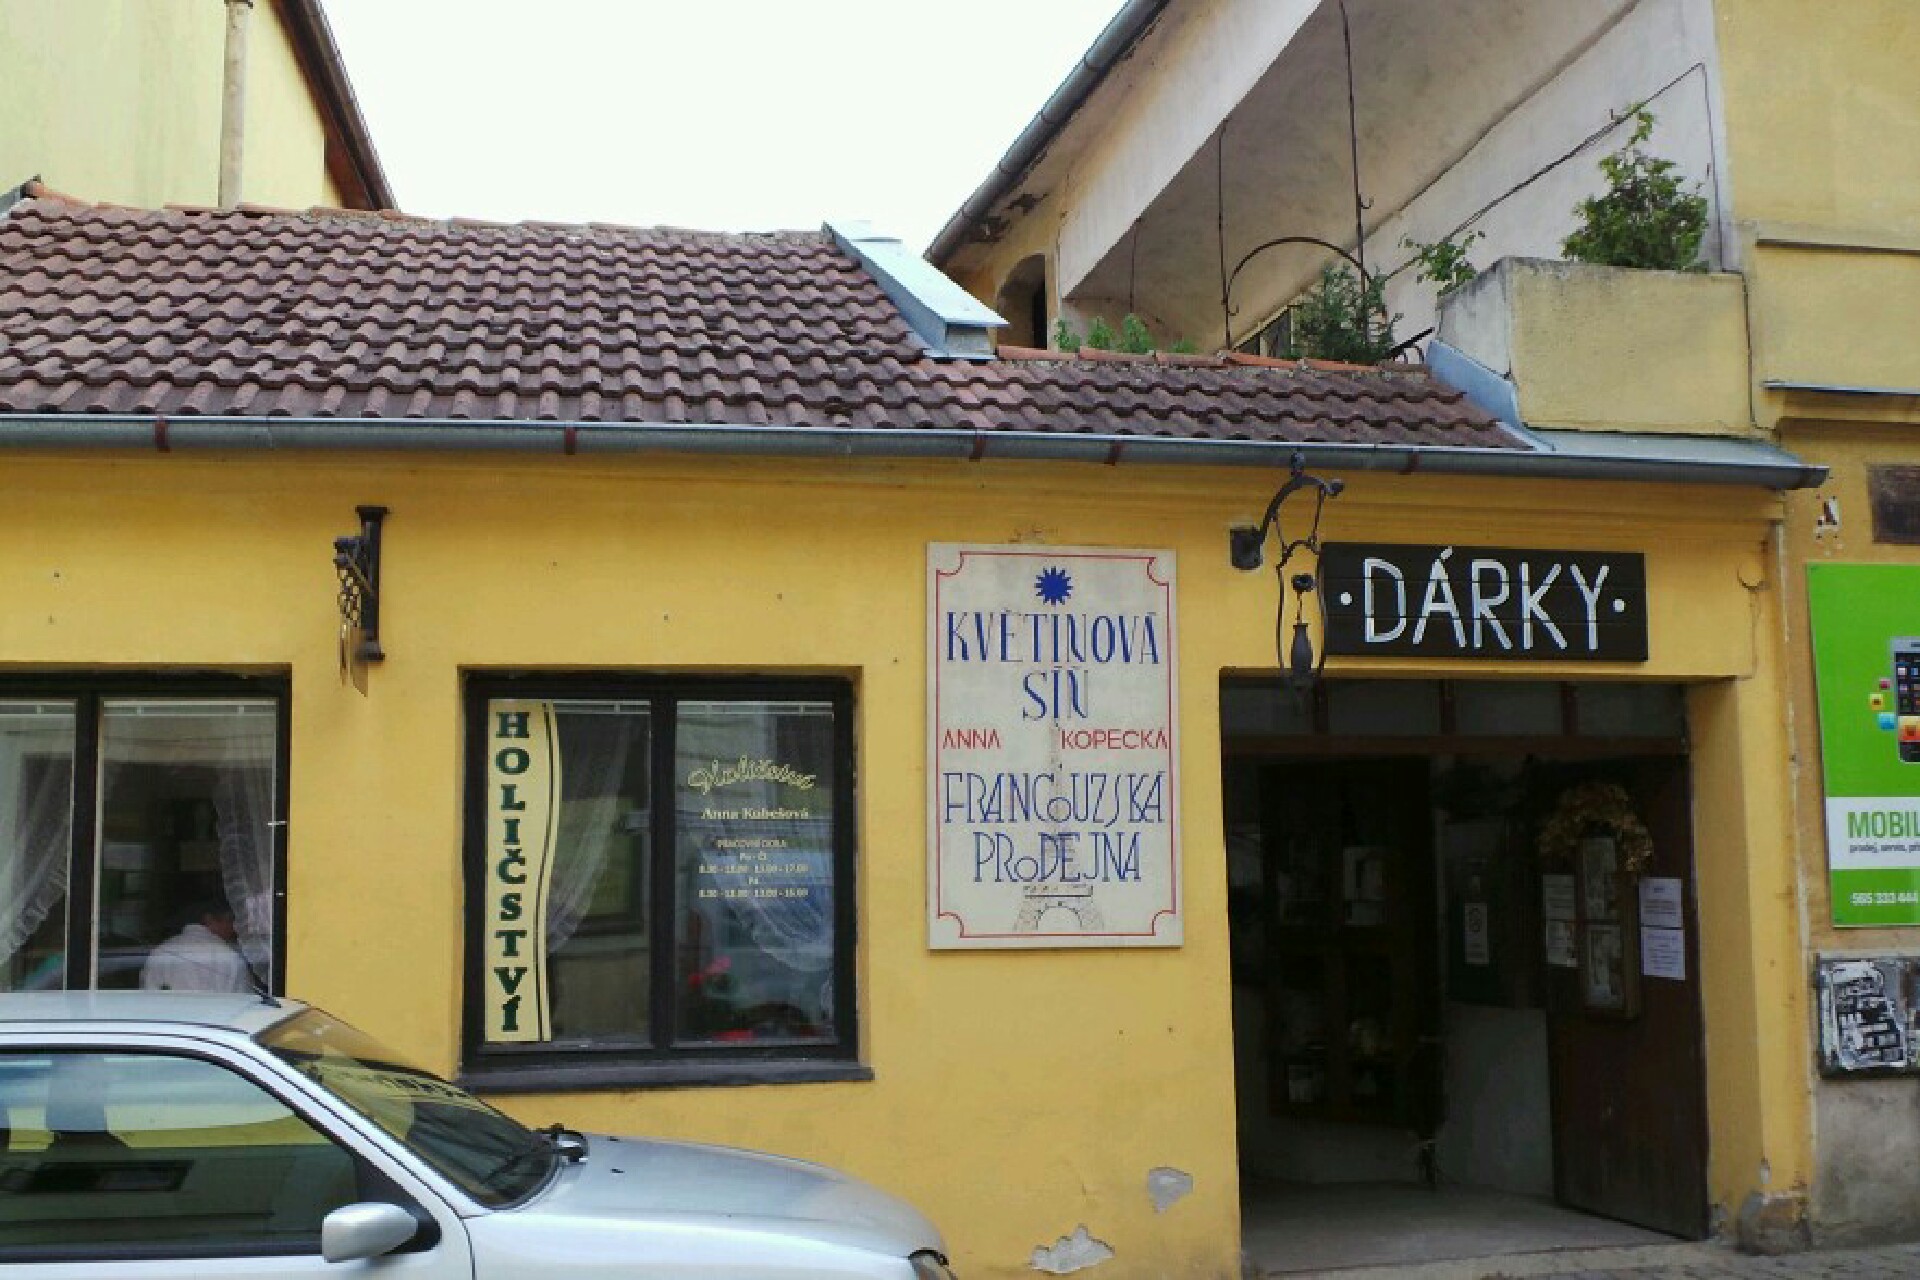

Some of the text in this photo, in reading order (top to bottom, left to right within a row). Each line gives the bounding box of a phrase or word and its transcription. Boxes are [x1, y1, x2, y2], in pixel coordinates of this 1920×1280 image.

[1363, 546, 1610, 650] DÁRKY
[946, 607, 1159, 664] KVĚTINOVÁ
[1022, 665, 1089, 721] SÍŇ
[942, 728, 1001, 750] ANNA
[701, 807, 809, 820] Anna Kubešová
[943, 770, 1166, 828] FRANCOUZSKÁ
[494, 711, 530, 1032] HOLIČSTVÍ
[972, 830, 1142, 883] PRODEJNA
